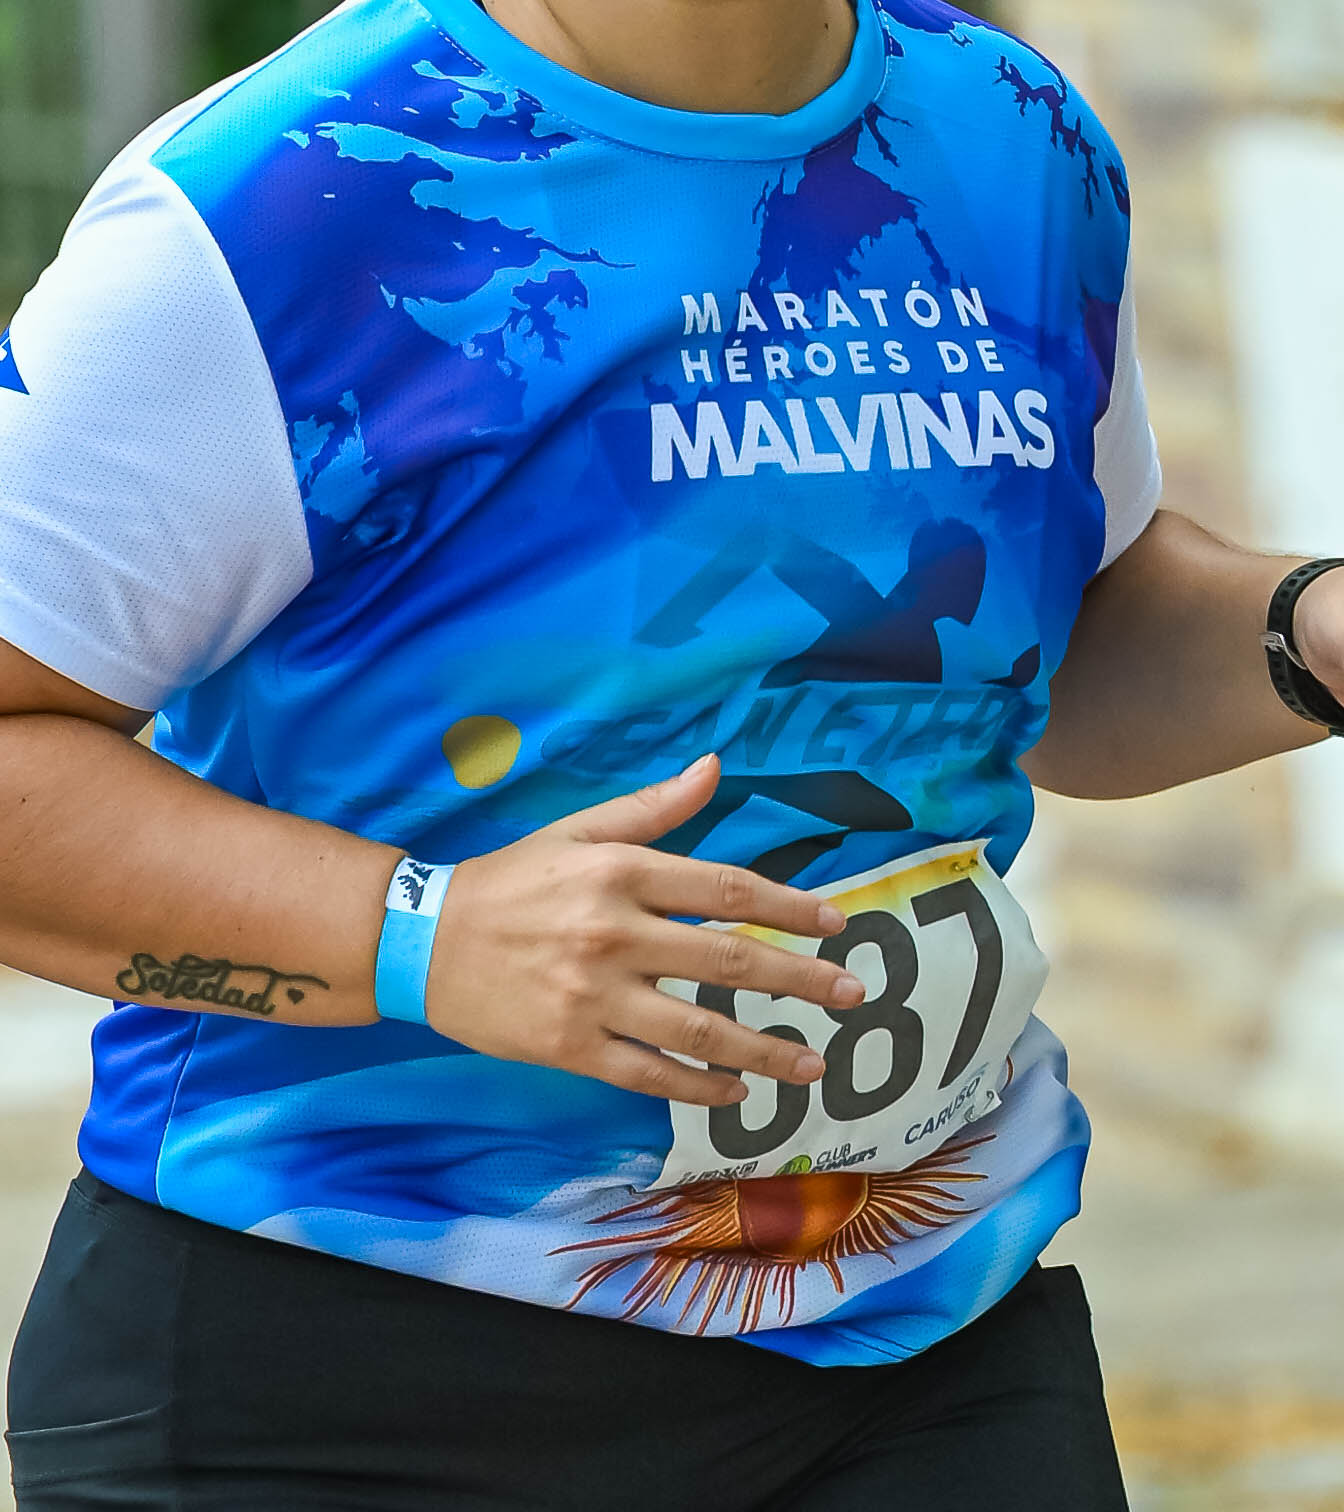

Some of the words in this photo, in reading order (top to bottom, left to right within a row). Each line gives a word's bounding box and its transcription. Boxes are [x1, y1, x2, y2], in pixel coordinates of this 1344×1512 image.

[680, 280, 990, 336] MARATÓN
[680, 338, 912, 384] HÉROES
[938, 338, 1006, 373] DE
[651, 389, 1055, 482] MALVINAS
[116, 952, 330, 1016] Soledad
[816, 1142, 852, 1166] CLUB
